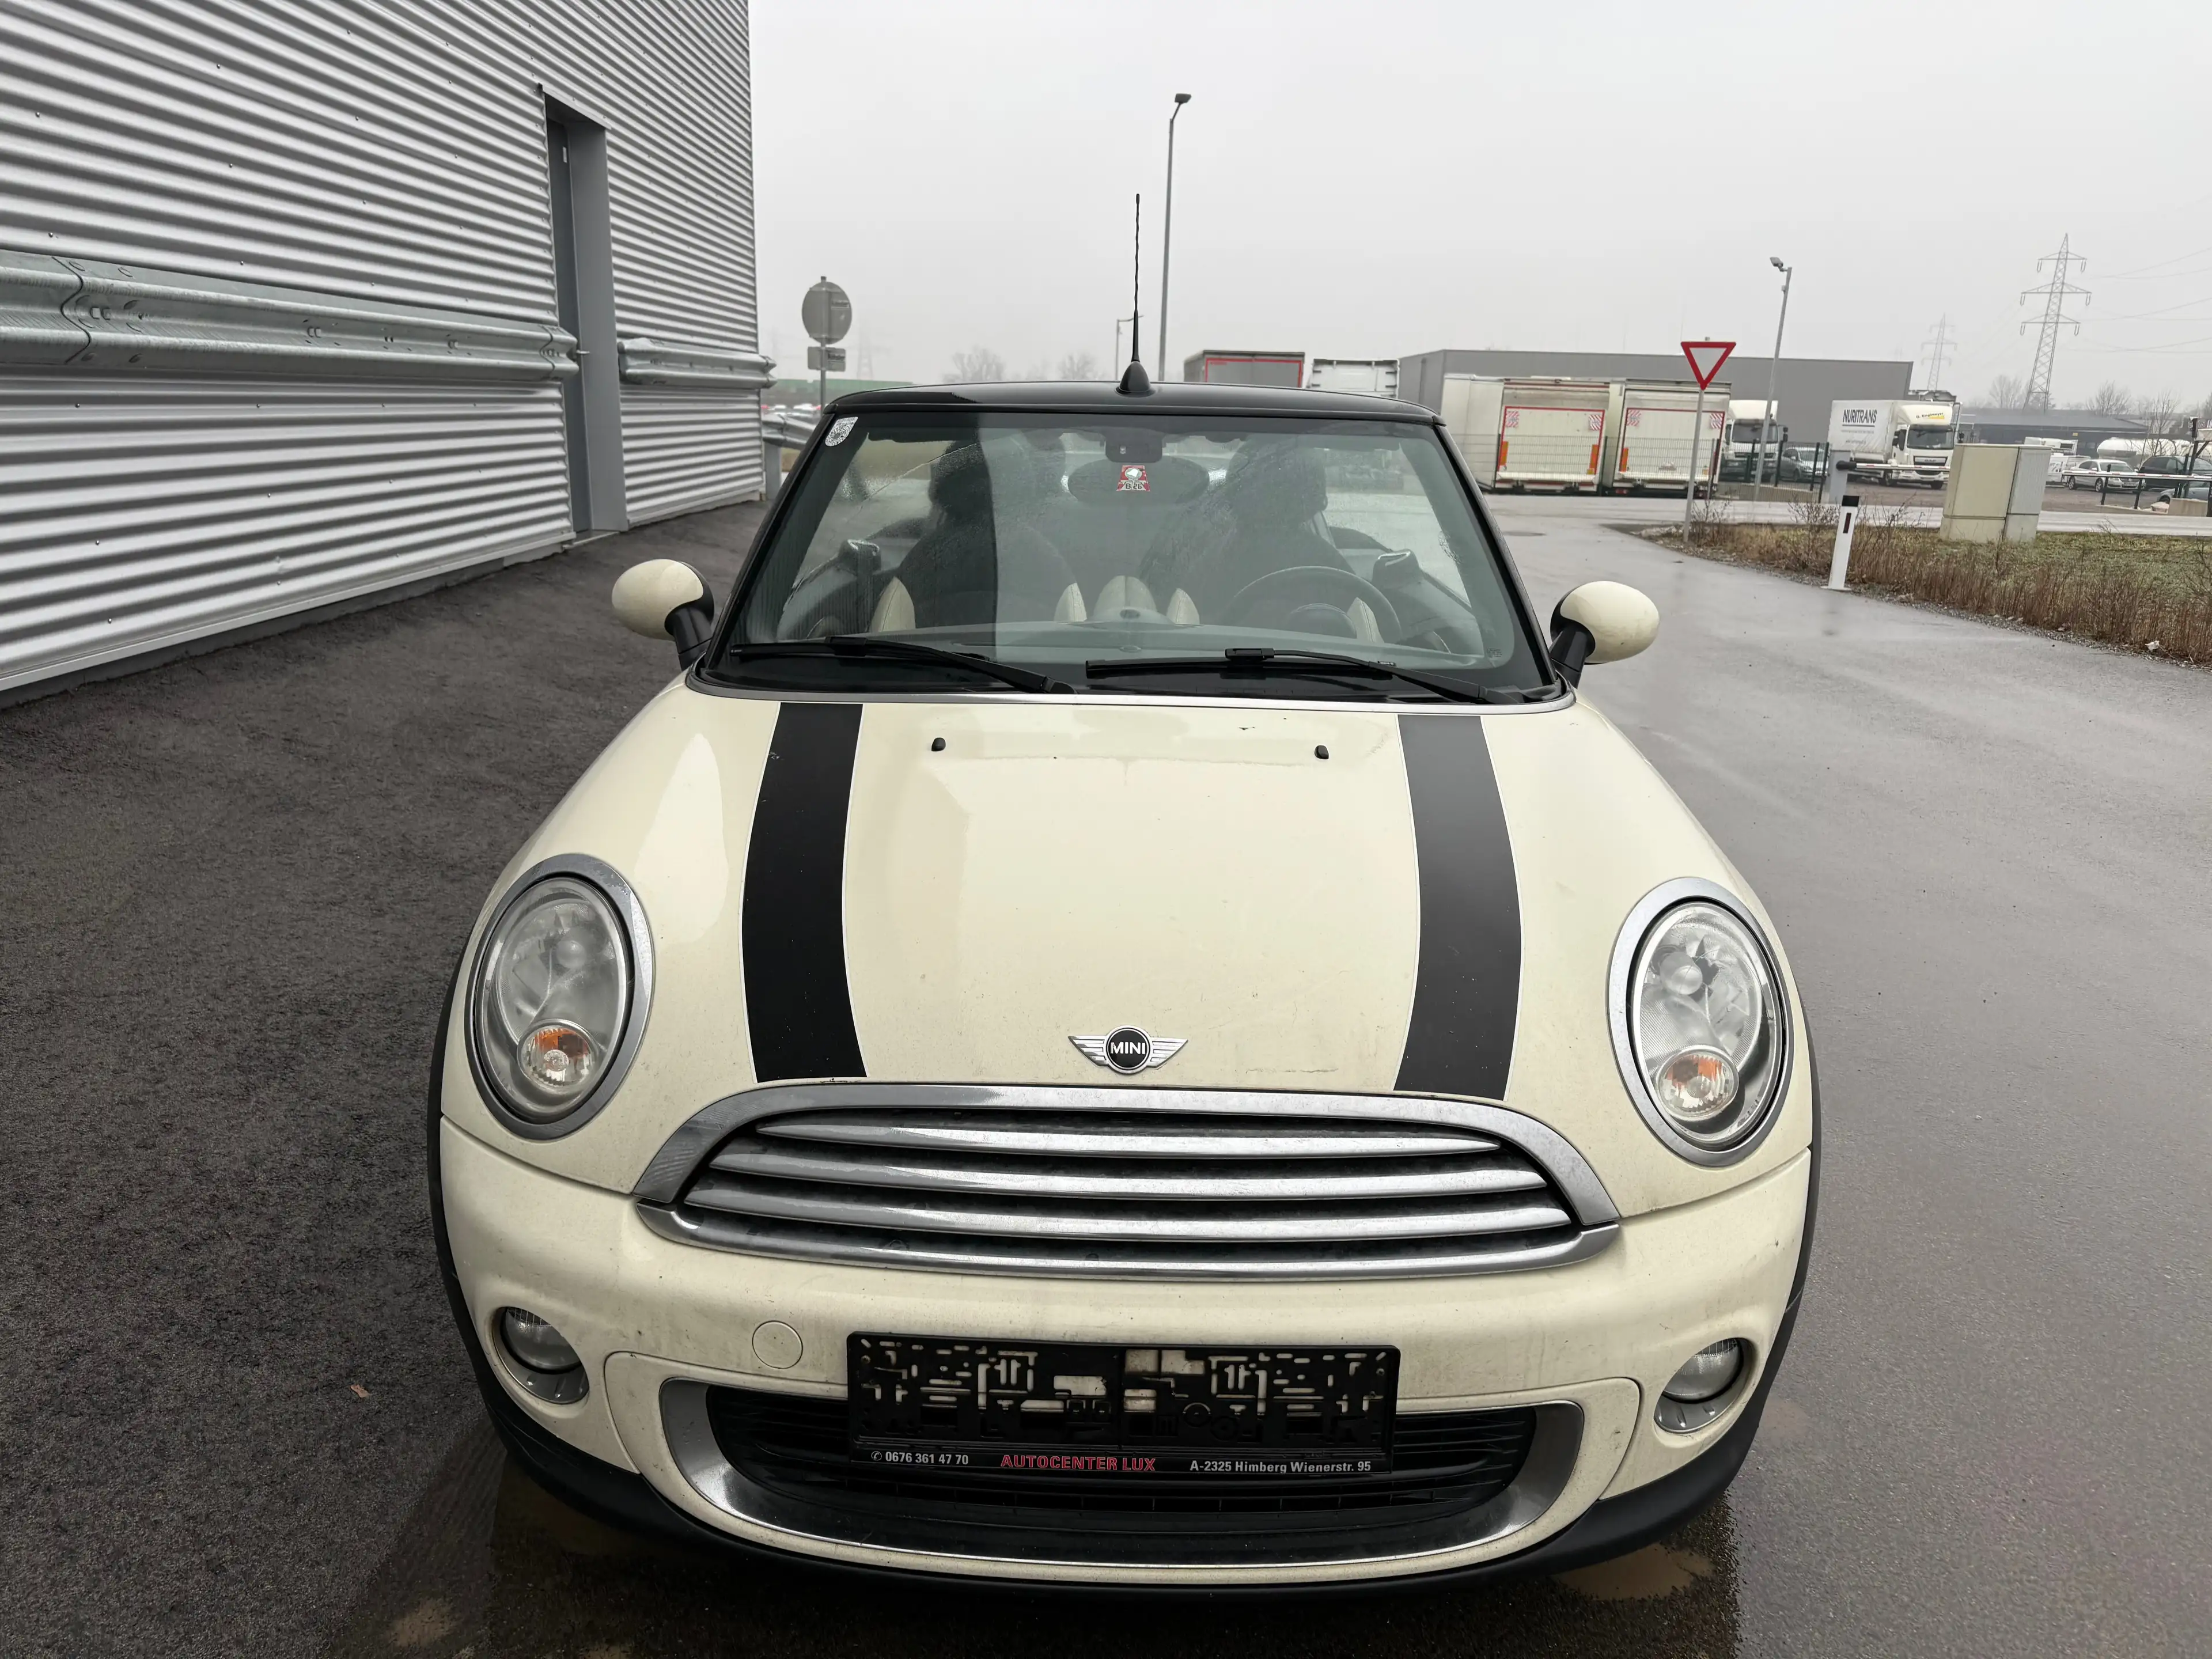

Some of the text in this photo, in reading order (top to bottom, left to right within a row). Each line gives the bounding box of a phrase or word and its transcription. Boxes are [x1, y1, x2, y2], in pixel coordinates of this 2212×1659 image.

[1843, 410, 1877, 423] NURITRANS
[1111, 1041, 1146, 1055] MINI
[885, 1452, 968, 1465] 0676 361 47 70
[1001, 1455, 1156, 1472] AUTOCENTER LUX
[1190, 1460, 1371, 1474] A-2325 Himberg Wienerstr. 95
